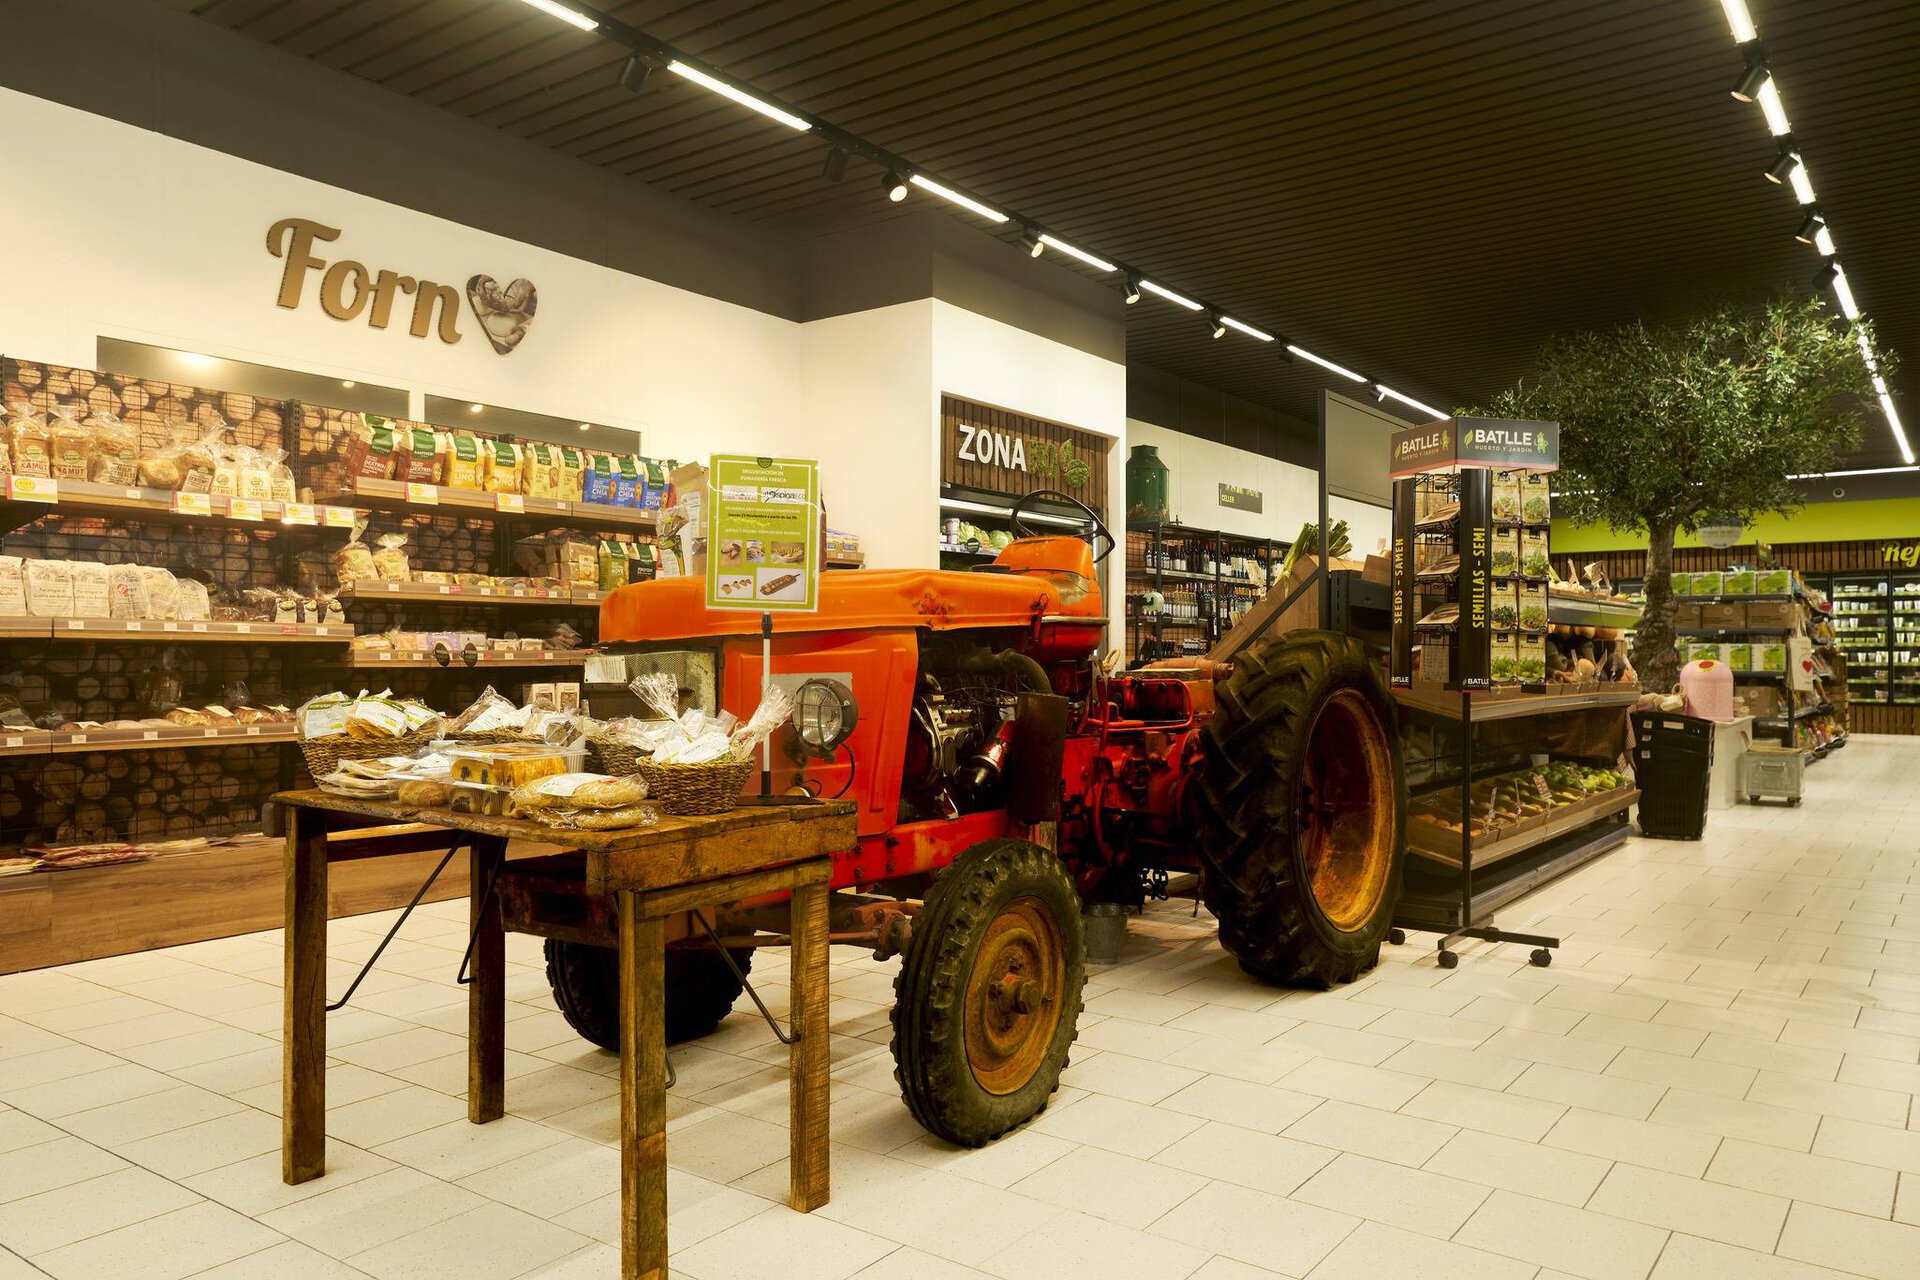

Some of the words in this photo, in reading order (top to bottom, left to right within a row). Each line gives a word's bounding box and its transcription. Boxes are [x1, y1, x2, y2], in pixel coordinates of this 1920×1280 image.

[266, 218, 462, 344] Forn
[959, 424, 1027, 472] ZONA
[1401, 433, 1439, 454] BATLLE
[1475, 429, 1532, 446] BATLLE
[591, 487, 608, 497] CHIA
[618, 490, 635, 498] CHIA
[1395, 538, 1404, 576] SAMEN
[1473, 527, 1485, 557] SEMI
[1394, 589, 1403, 624] SEEDS
[1472, 570, 1485, 628] SEMILLAS
